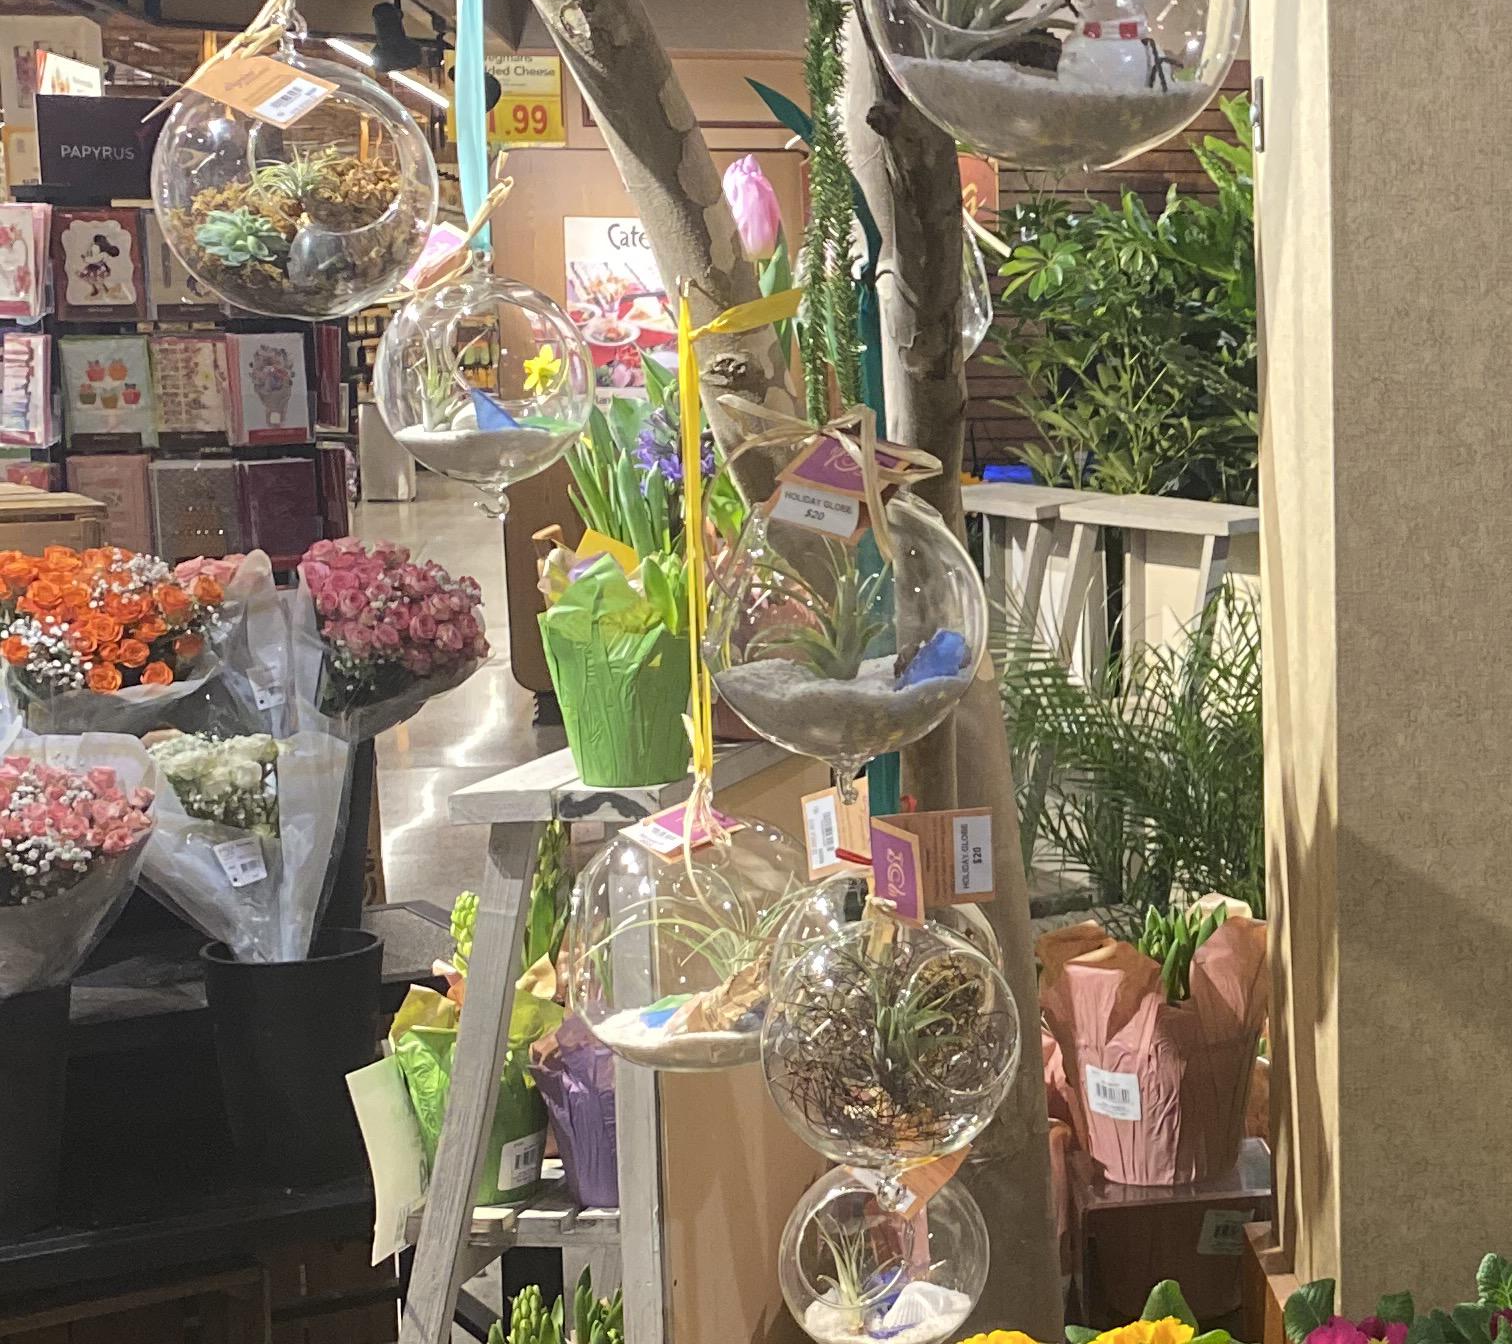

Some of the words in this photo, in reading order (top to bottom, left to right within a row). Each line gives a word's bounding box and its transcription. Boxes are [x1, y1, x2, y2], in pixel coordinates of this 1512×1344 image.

[60, 144, 135, 160] PAPYRUS
[607, 223, 652, 250] Cate
[785, 490, 821, 507] HOLIDAY
[823, 499, 853, 515] GLOBE
[804, 508, 825, 521] $20
[960, 823, 970, 852] GLOBE
[972, 846, 983, 865] $20
[960, 854, 970, 890] HOLIDAY
